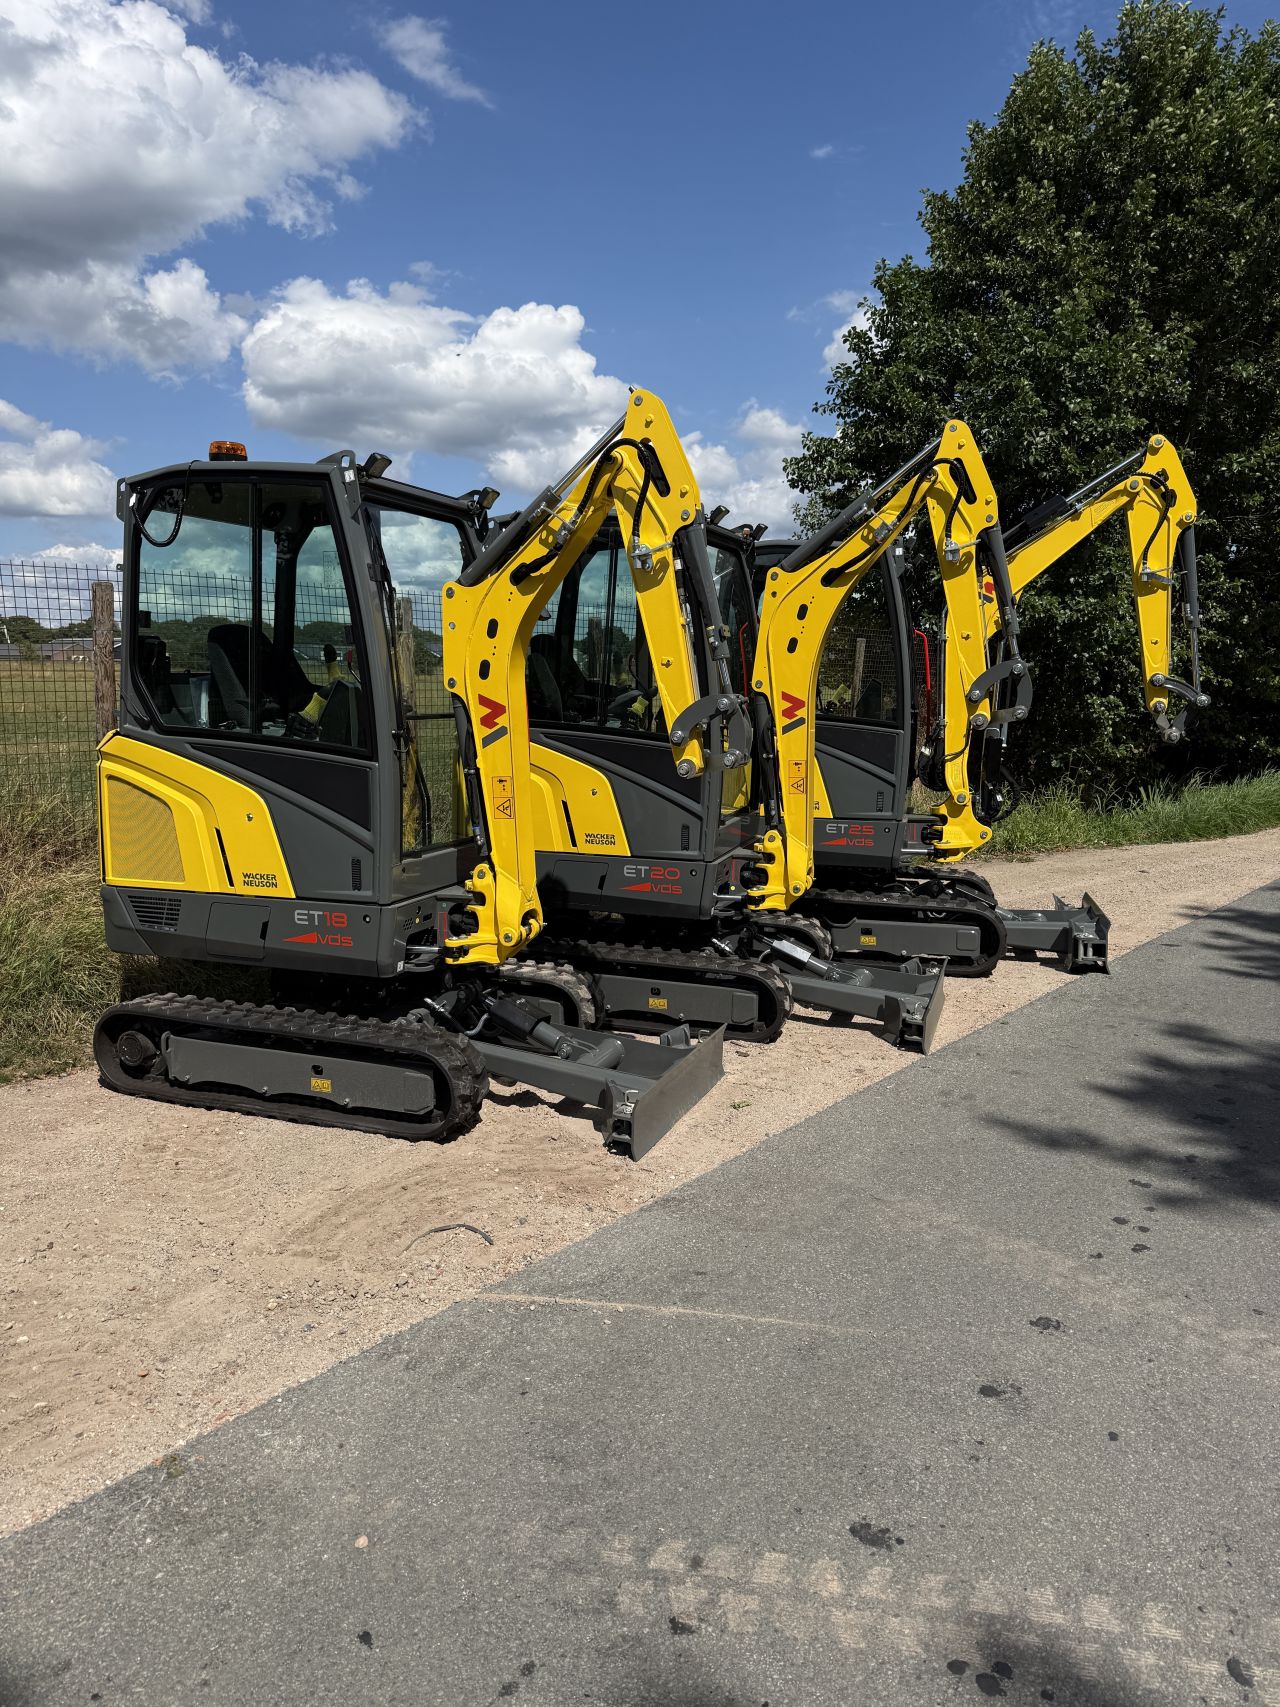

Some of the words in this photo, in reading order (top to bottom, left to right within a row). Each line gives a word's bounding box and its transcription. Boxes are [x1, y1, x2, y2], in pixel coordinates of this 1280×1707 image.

[826, 823, 875, 835] ET25
[847, 838, 875, 847] vds
[242, 872, 277, 882] WACKER
[623, 865, 681, 880] ET20
[243, 880, 278, 889] NEUSON
[651, 884, 683, 895] vds
[294, 909, 348, 928] ET18
[317, 933, 353, 947] vds
